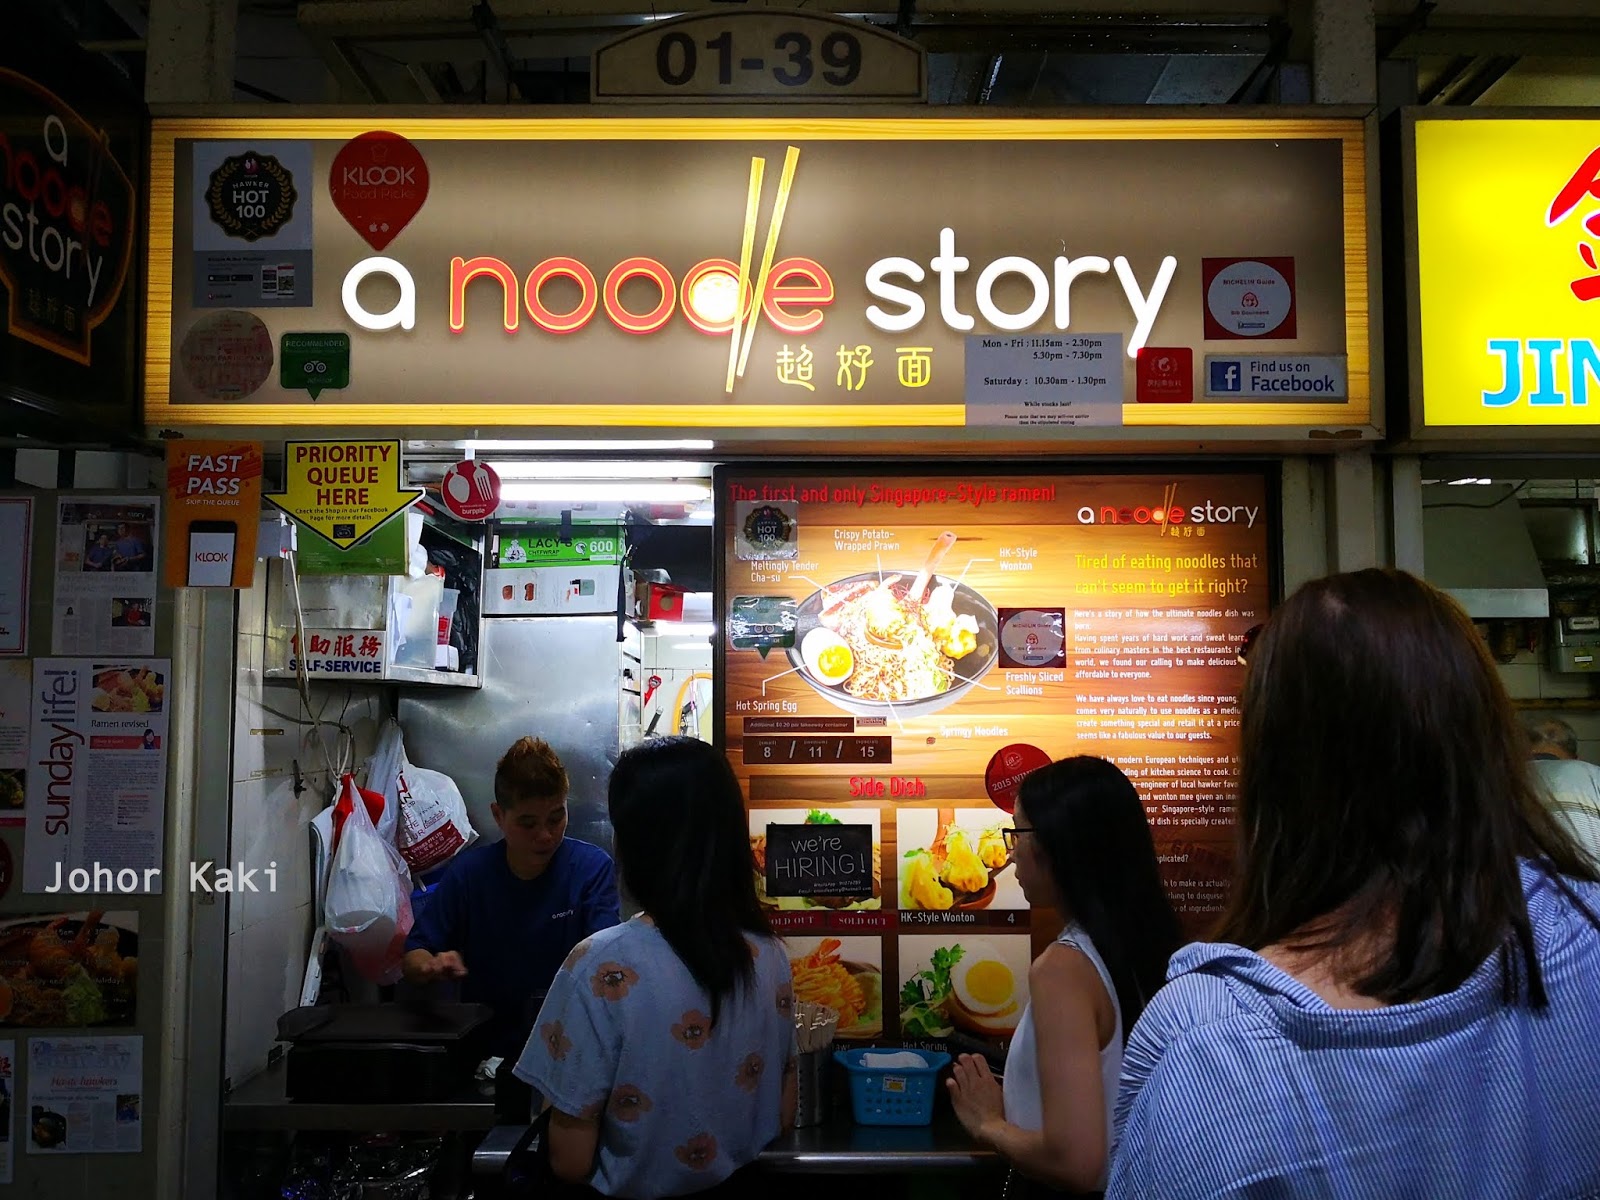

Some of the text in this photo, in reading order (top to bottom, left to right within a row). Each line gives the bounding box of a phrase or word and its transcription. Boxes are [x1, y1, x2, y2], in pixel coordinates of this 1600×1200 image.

[656, 31, 863, 87] 01-39
[44, 115, 68, 168] a
[343, 166, 415, 186] KLOOK
[232, 181, 270, 189] HAWKER
[232, 190, 270, 203] HOT
[343, 189, 377, 200] Food
[236, 205, 266, 218] 100
[2, 202, 103, 308] story
[341, 256, 416, 332] a
[865, 227, 1178, 359] story
[285, 340, 345, 348] RECOMMENDED
[982, 338, 1102, 350] Mon Fri 11.15am 2.30pm
[1033, 351, 1103, 361] 5.30pm 7.30pm
[776, 343, 934, 392] 超好面
[1250, 361, 1310, 372] Find us on
[984, 376, 1107, 387] Saturday 10.30am 1.30pm
[1250, 375, 1335, 393] Facebook
[296, 445, 392, 463] PRIORITY
[188, 455, 242, 473] FAST
[307, 466, 379, 486] QUEUE
[187, 477, 241, 496] PASS
[316, 488, 369, 506] HERE
[730, 483, 1056, 507] The first and only Singapore-Style ramen!
[217, 499, 240, 507] QUEUE
[461, 507, 486, 515] burpple
[1077, 506, 1095, 524] a
[1190, 500, 1259, 529] story
[757, 526, 777, 534] HOT
[834, 529, 895, 541] Crispy Potato-
[759, 534, 776, 542] 100
[589, 540, 613, 553] 600
[834, 541, 900, 553] Wrapped Prawn
[194, 551, 228, 562] KLOOK
[999, 548, 1038, 560] HK-Style
[751, 561, 820, 574] Meltingly Tender
[999, 561, 1033, 571] Wonton
[1075, 554, 1258, 573] Tired of eating noodles that
[751, 572, 781, 582] Cha-su
[1076, 579, 1249, 598] can't seem to get it right?
[1005, 671, 1064, 684] Freshly Sliced
[1075, 670, 1152, 680] affordable to everyone.
[1005, 685, 1043, 696] Scallions
[1076, 694, 1087, 703] We
[1088, 694, 1104, 703] have
[1106, 694, 1129, 705] always
[1131, 694, 1145, 703] love
[1147, 695, 1155, 703] to
[1157, 695, 1168, 703] eat
[1170, 694, 1196, 703] noodles
[1197, 694, 1215, 703] since
[736, 700, 798, 713] Hot Spring Egg
[91, 719, 149, 728] Ramen revised
[940, 726, 1009, 739] Springy Noodles
[1076, 732, 1098, 740] seems
[1099, 731, 1111, 740] like
[1117, 731, 1147, 740] fabulous
[1148, 731, 1166, 740] value
[1166, 732, 1175, 740] to
[1188, 732, 1213, 742] guests.
[763, 746, 875, 758] 8 11 15
[1117, 755, 1229, 766] modern European techniques and
[849, 776, 926, 797] Side Dish
[991, 778, 1012, 792] 2015
[791, 835, 842, 854] we're
[770, 916, 815, 926] OLD OUT
[838, 917, 887, 926] SOLD OUT
[900, 912, 1015, 926] HK-Style Wonton 4
[920, 1041, 948, 1051] Spring
